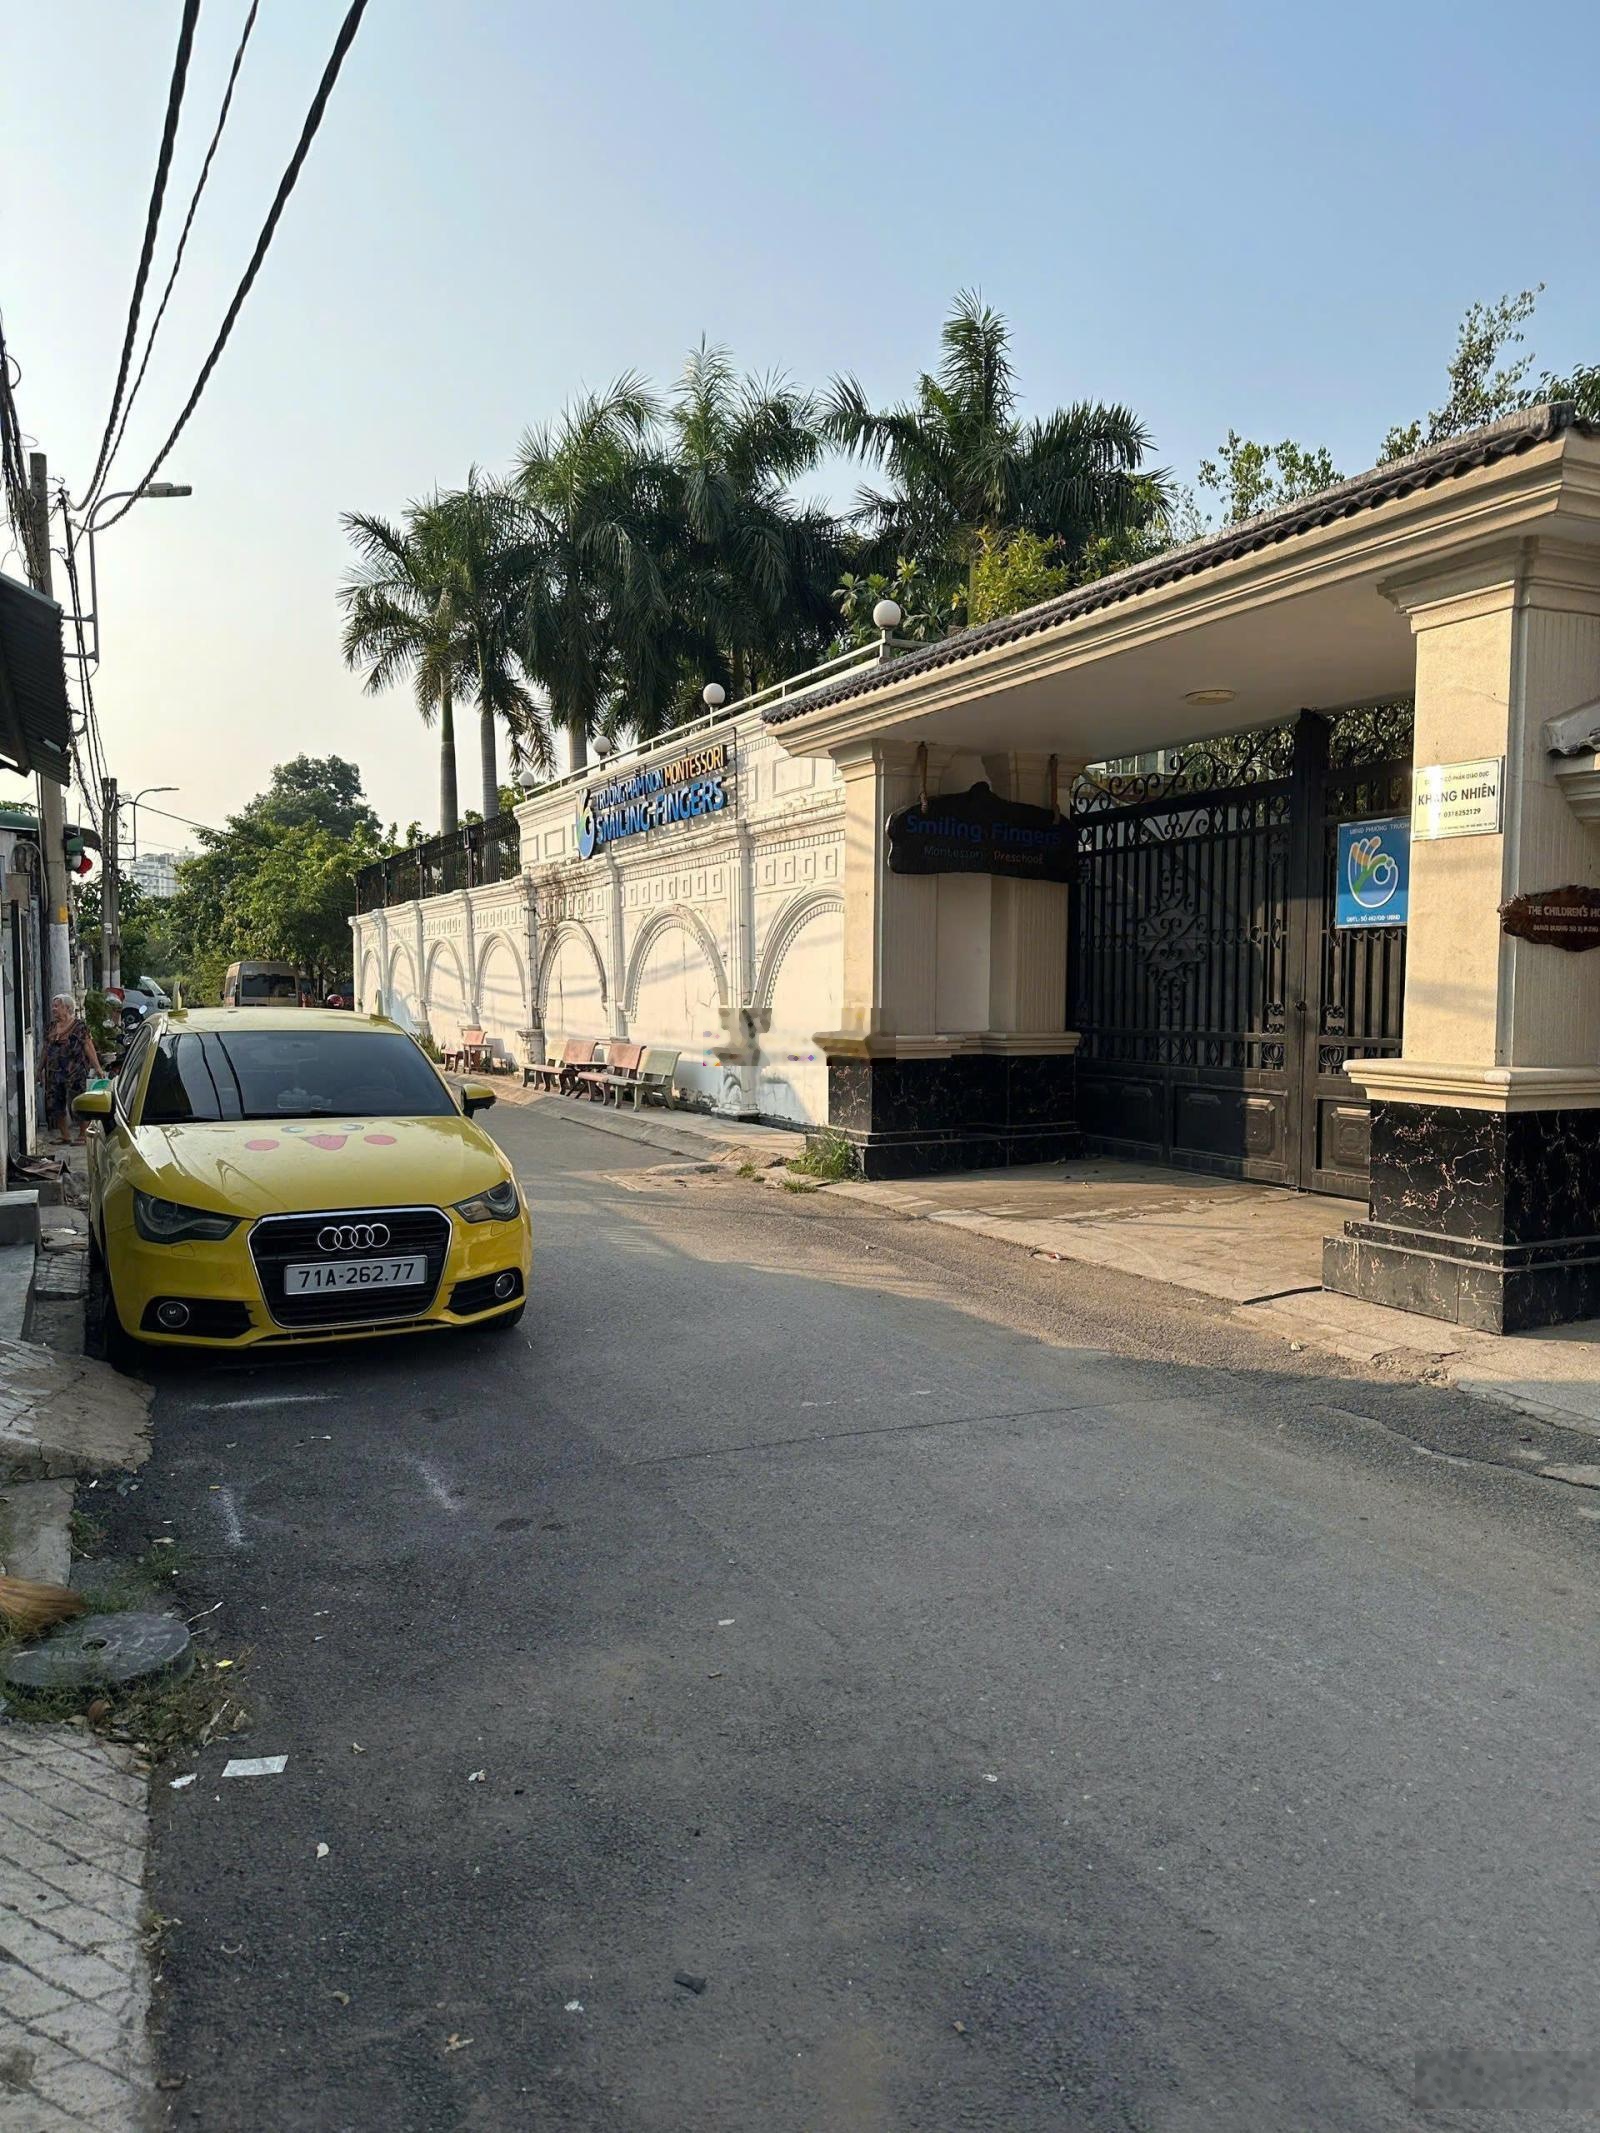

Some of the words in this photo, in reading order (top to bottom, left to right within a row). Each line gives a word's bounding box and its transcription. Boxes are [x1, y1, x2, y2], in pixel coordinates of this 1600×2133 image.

[646, 768, 664, 792] NON
[664, 745, 724, 786] MONTESSORI
[1418, 790, 1458, 806] KHNG
[1461, 783, 1496, 801] NHIÊN
[596, 802, 650, 845] SMILING
[655, 777, 724, 827] FINGERS
[905, 815, 982, 843] Smiling
[992, 822, 1062, 847] Fingers
[924, 845, 984, 859] Montessori
[993, 849, 1043, 865] Preschool
[1528, 906, 1542, 916] THE
[1543, 905, 1589, 918] CHILDREN'S
[299, 1263, 415, 1288] 71A-262.77
